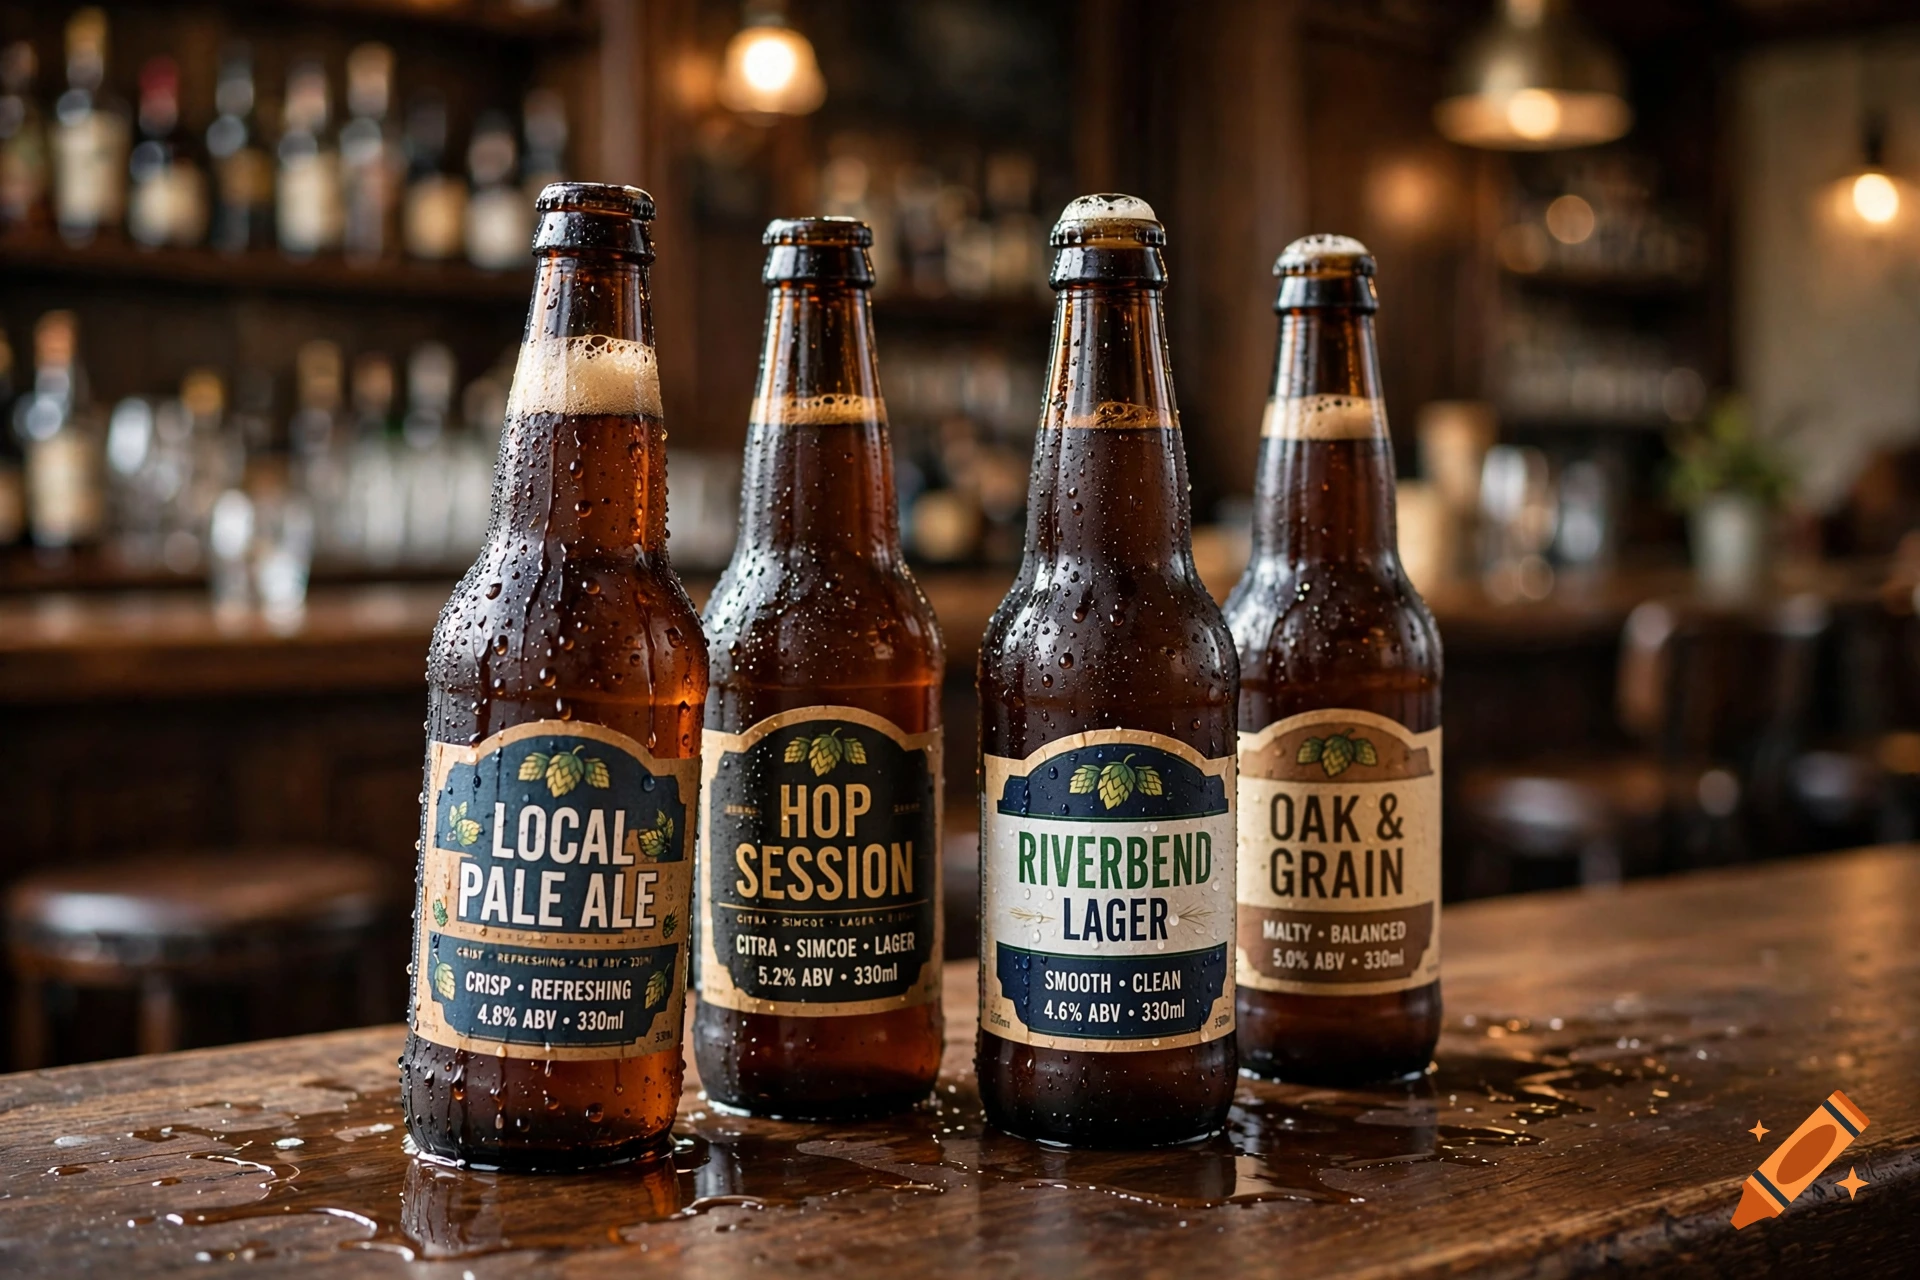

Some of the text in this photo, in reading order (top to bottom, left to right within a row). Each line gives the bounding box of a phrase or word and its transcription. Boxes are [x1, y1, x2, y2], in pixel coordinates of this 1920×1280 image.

[780, 783, 872, 839] HOP
[1270, 793, 1404, 843] OAK &
[491, 802, 635, 865] LOCAL
[735, 841, 913, 901] SESSION
[1018, 831, 1212, 889] RIVERBEND
[1270, 847, 1404, 899] GRAIN
[458, 862, 658, 929] PALE ALE
[1063, 897, 1168, 942] LAGER
[1263, 919, 1407, 944] MALTY BALANCED
[736, 931, 915, 958] CITRA SIMCOE LAGER
[1272, 948, 1309, 970] 5.0%
[1314, 951, 1345, 971] ABV
[1363, 948, 1404, 970] 330ml
[465, 970, 632, 1000] CRISP REFRESHING
[758, 962, 898, 987] 5.2% ABV 330ml
[1045, 970, 1181, 994] SMOOTH CLEAN
[477, 1003, 624, 1031] 4.8% ABV 330ml
[1044, 998, 1185, 1023] 4.6% ABV 330ml
